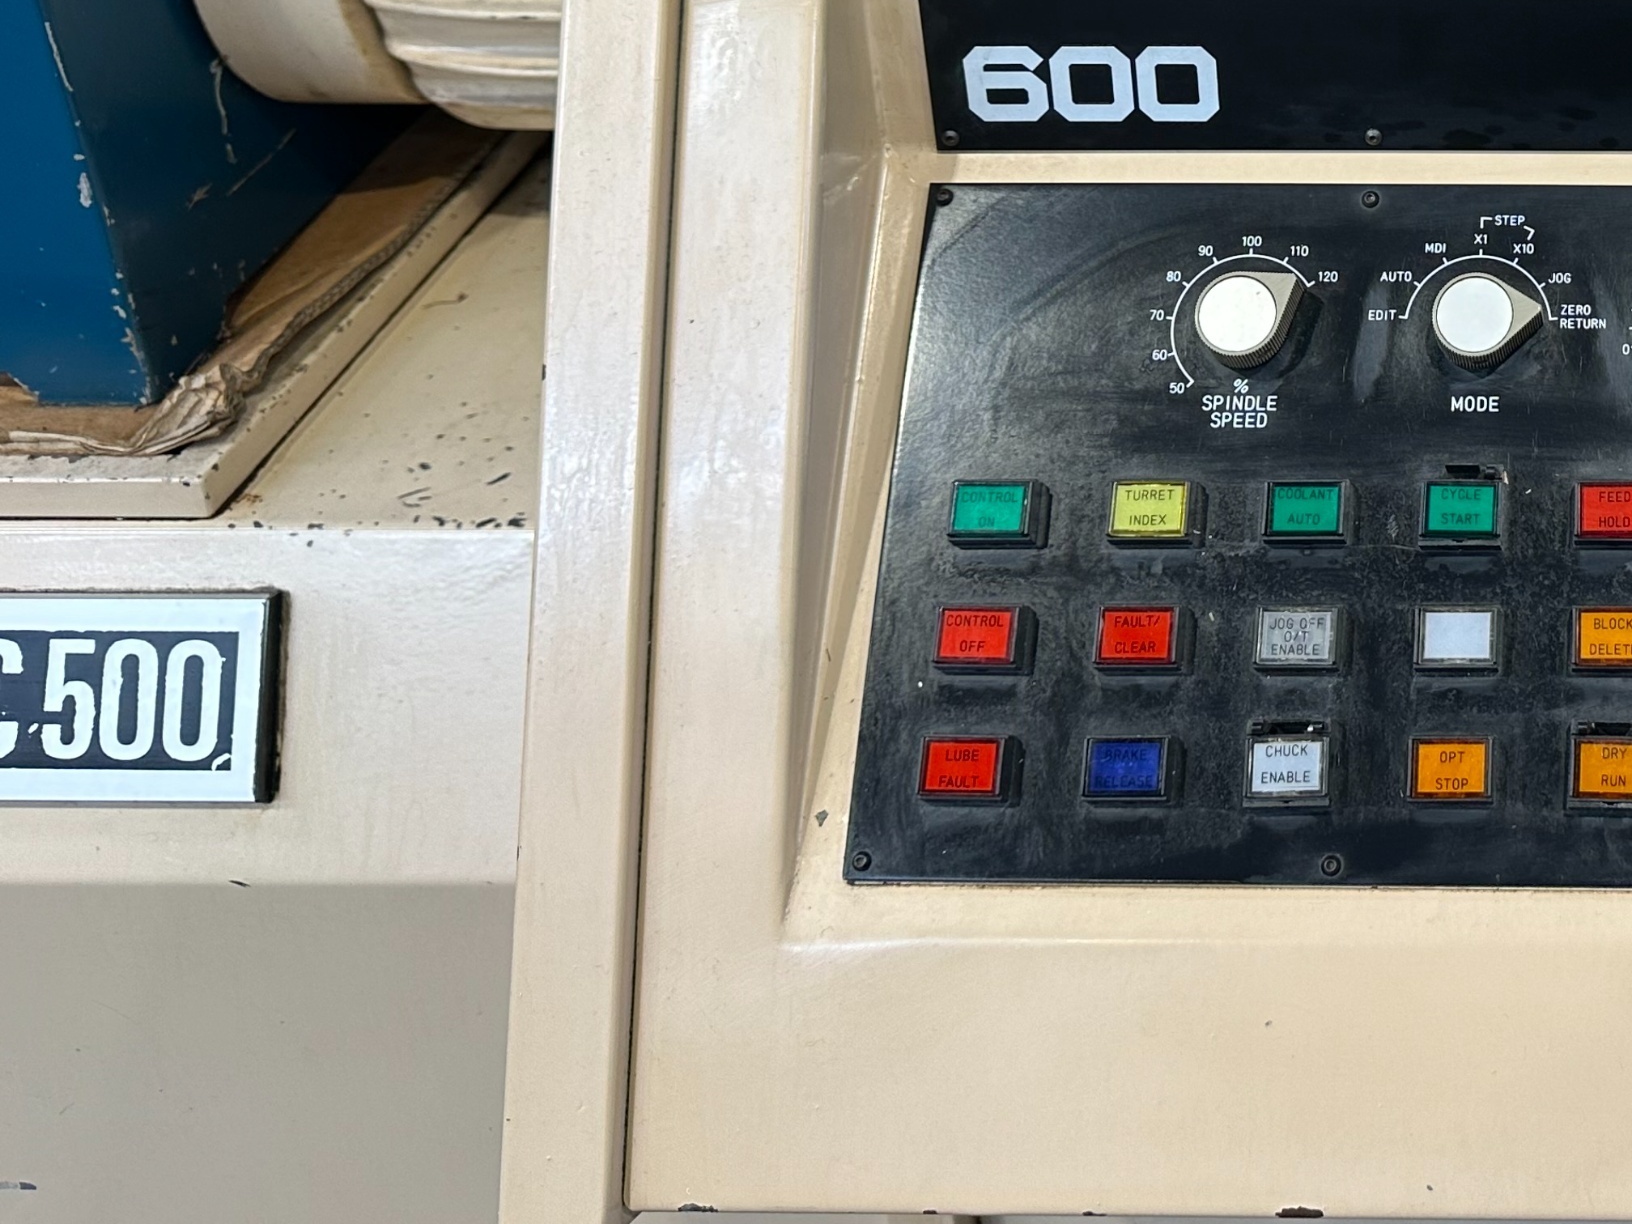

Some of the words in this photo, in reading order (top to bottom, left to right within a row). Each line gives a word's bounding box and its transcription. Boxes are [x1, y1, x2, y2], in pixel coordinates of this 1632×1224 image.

[963, 45, 1220, 122] 600
[1494, 215, 1525, 226] STEP
[1242, 236, 1262, 247] 100
[1474, 234, 1488, 245] X1
[1198, 245, 1213, 257] 90
[1290, 245, 1309, 256] 110
[1425, 243, 1446, 253] MDI
[1513, 243, 1534, 255] X10
[1166, 271, 1181, 282] 80
[1318, 271, 1338, 283] 120
[1380, 271, 1412, 283] AUTO
[1548, 273, 1571, 284] JOG
[1150, 310, 1165, 321] 70
[1368, 310, 1397, 321] EDIT
[1560, 305, 1592, 315] ZERO
[1559, 318, 1606, 330] RETURN
[1152, 349, 1168, 361] 60
[1622, 343, 1630, 356] 0
[1169, 382, 1185, 394] 50
[1233, 380, 1249, 393] %
[1202, 396, 1277, 411] SPINDLE
[1451, 397, 1500, 413] MODE
[1210, 413, 1268, 428] SPEED
[961, 491, 1018, 503] CONTROL
[1125, 489, 1176, 502] TURRET
[1277, 488, 1334, 500] COOLANT
[1441, 488, 1482, 501] CYCLE
[1599, 490, 1631, 503] FEED
[978, 516, 995, 528] ON
[1129, 513, 1167, 526] INDEX
[1287, 513, 1321, 525] AUTO
[1441, 513, 1480, 525] START
[1598, 515, 1631, 528] HOLD
[946, 614, 1004, 628] CONTROL
[1114, 615, 1161, 628] FAULT/
[1270, 618, 1294, 630] JOG
[1300, 618, 1324, 630] OFF
[959, 640, 986, 652] OFF
[1114, 640, 1156, 653] CLEAR
[1271, 644, 1320, 656] ENABLE
[41, 638, 222, 761] 500
[945, 749, 979, 762] LUBE
[1104, 748, 1148, 762] BRAKE
[1265, 744, 1308, 758] CHUCK
[1601, 747, 1627, 760] DRY
[1439, 751, 1465, 764] OPT
[938, 776, 979, 789] FAULT
[1260, 771, 1311, 784] ENABLE
[1435, 777, 1469, 790] STOP
[1601, 774, 1626, 787] RUN
